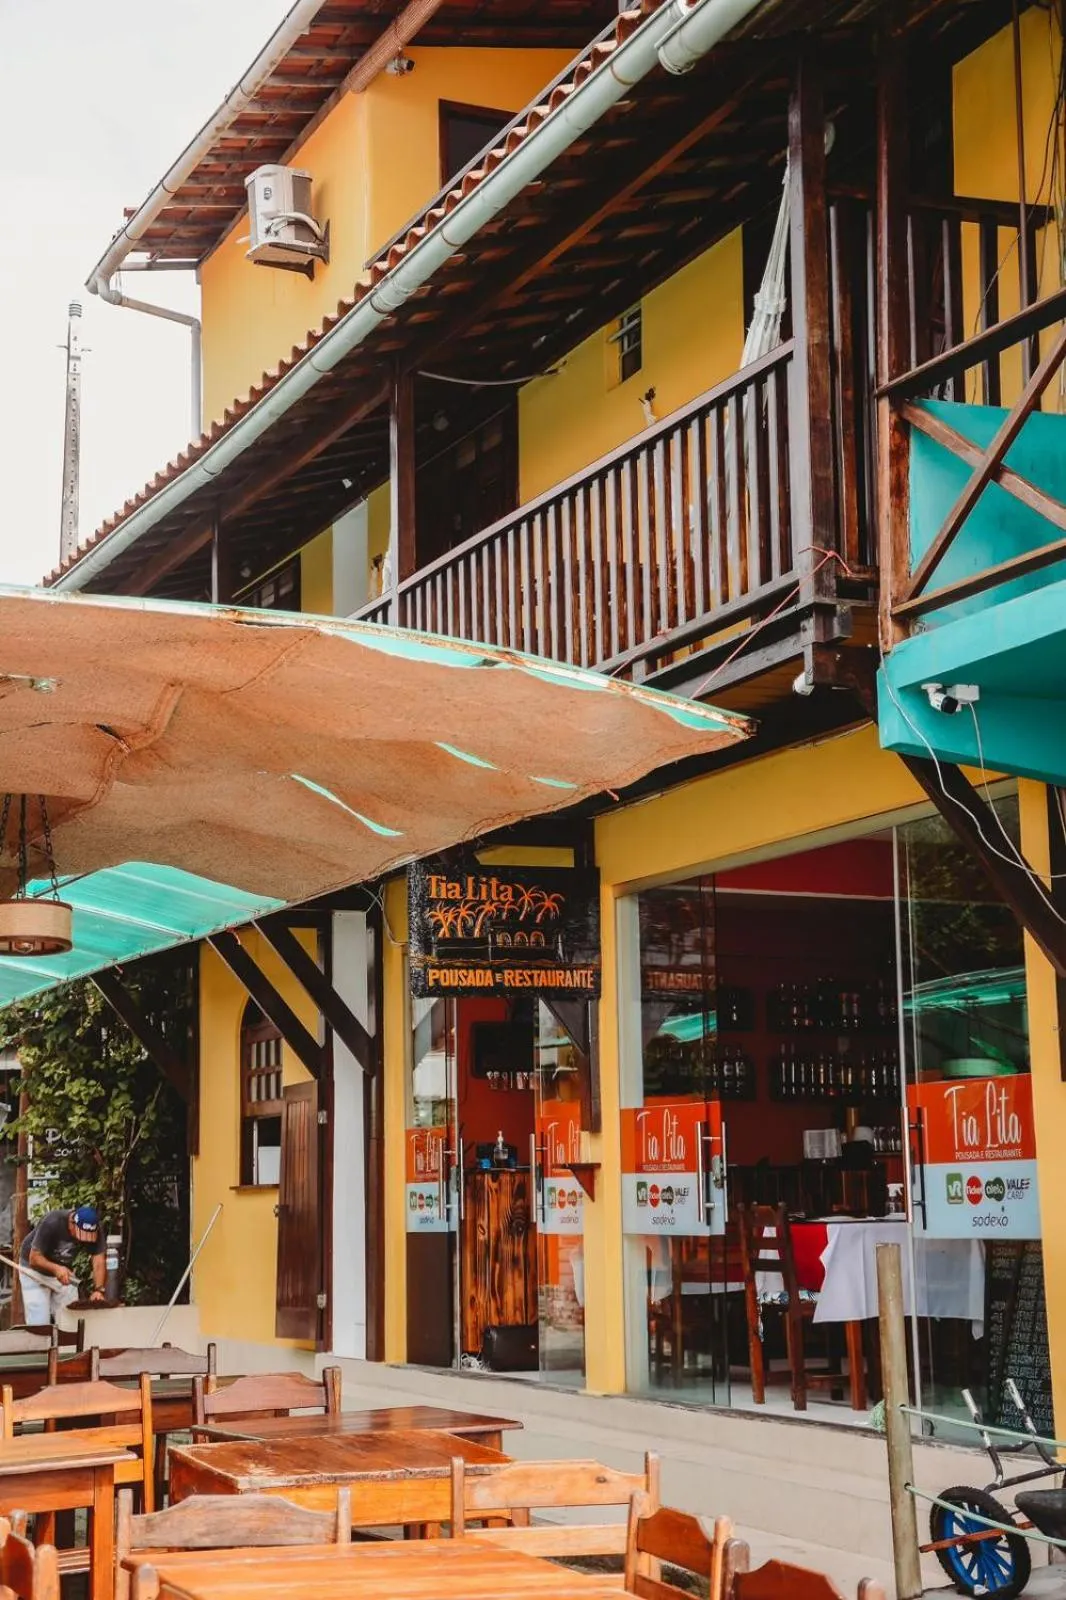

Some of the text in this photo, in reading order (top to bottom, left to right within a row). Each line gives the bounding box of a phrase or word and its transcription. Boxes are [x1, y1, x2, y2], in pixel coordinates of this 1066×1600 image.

[426, 875, 515, 901] Tia Lita
[428, 968, 494, 987] POUSADA
[503, 968, 595, 989] RESTAURANTE
[944, 1080, 1022, 1151] Tia Lita
[636, 1108, 686, 1163] Tia Lita
[972, 1213, 1009, 1227] sodexo
